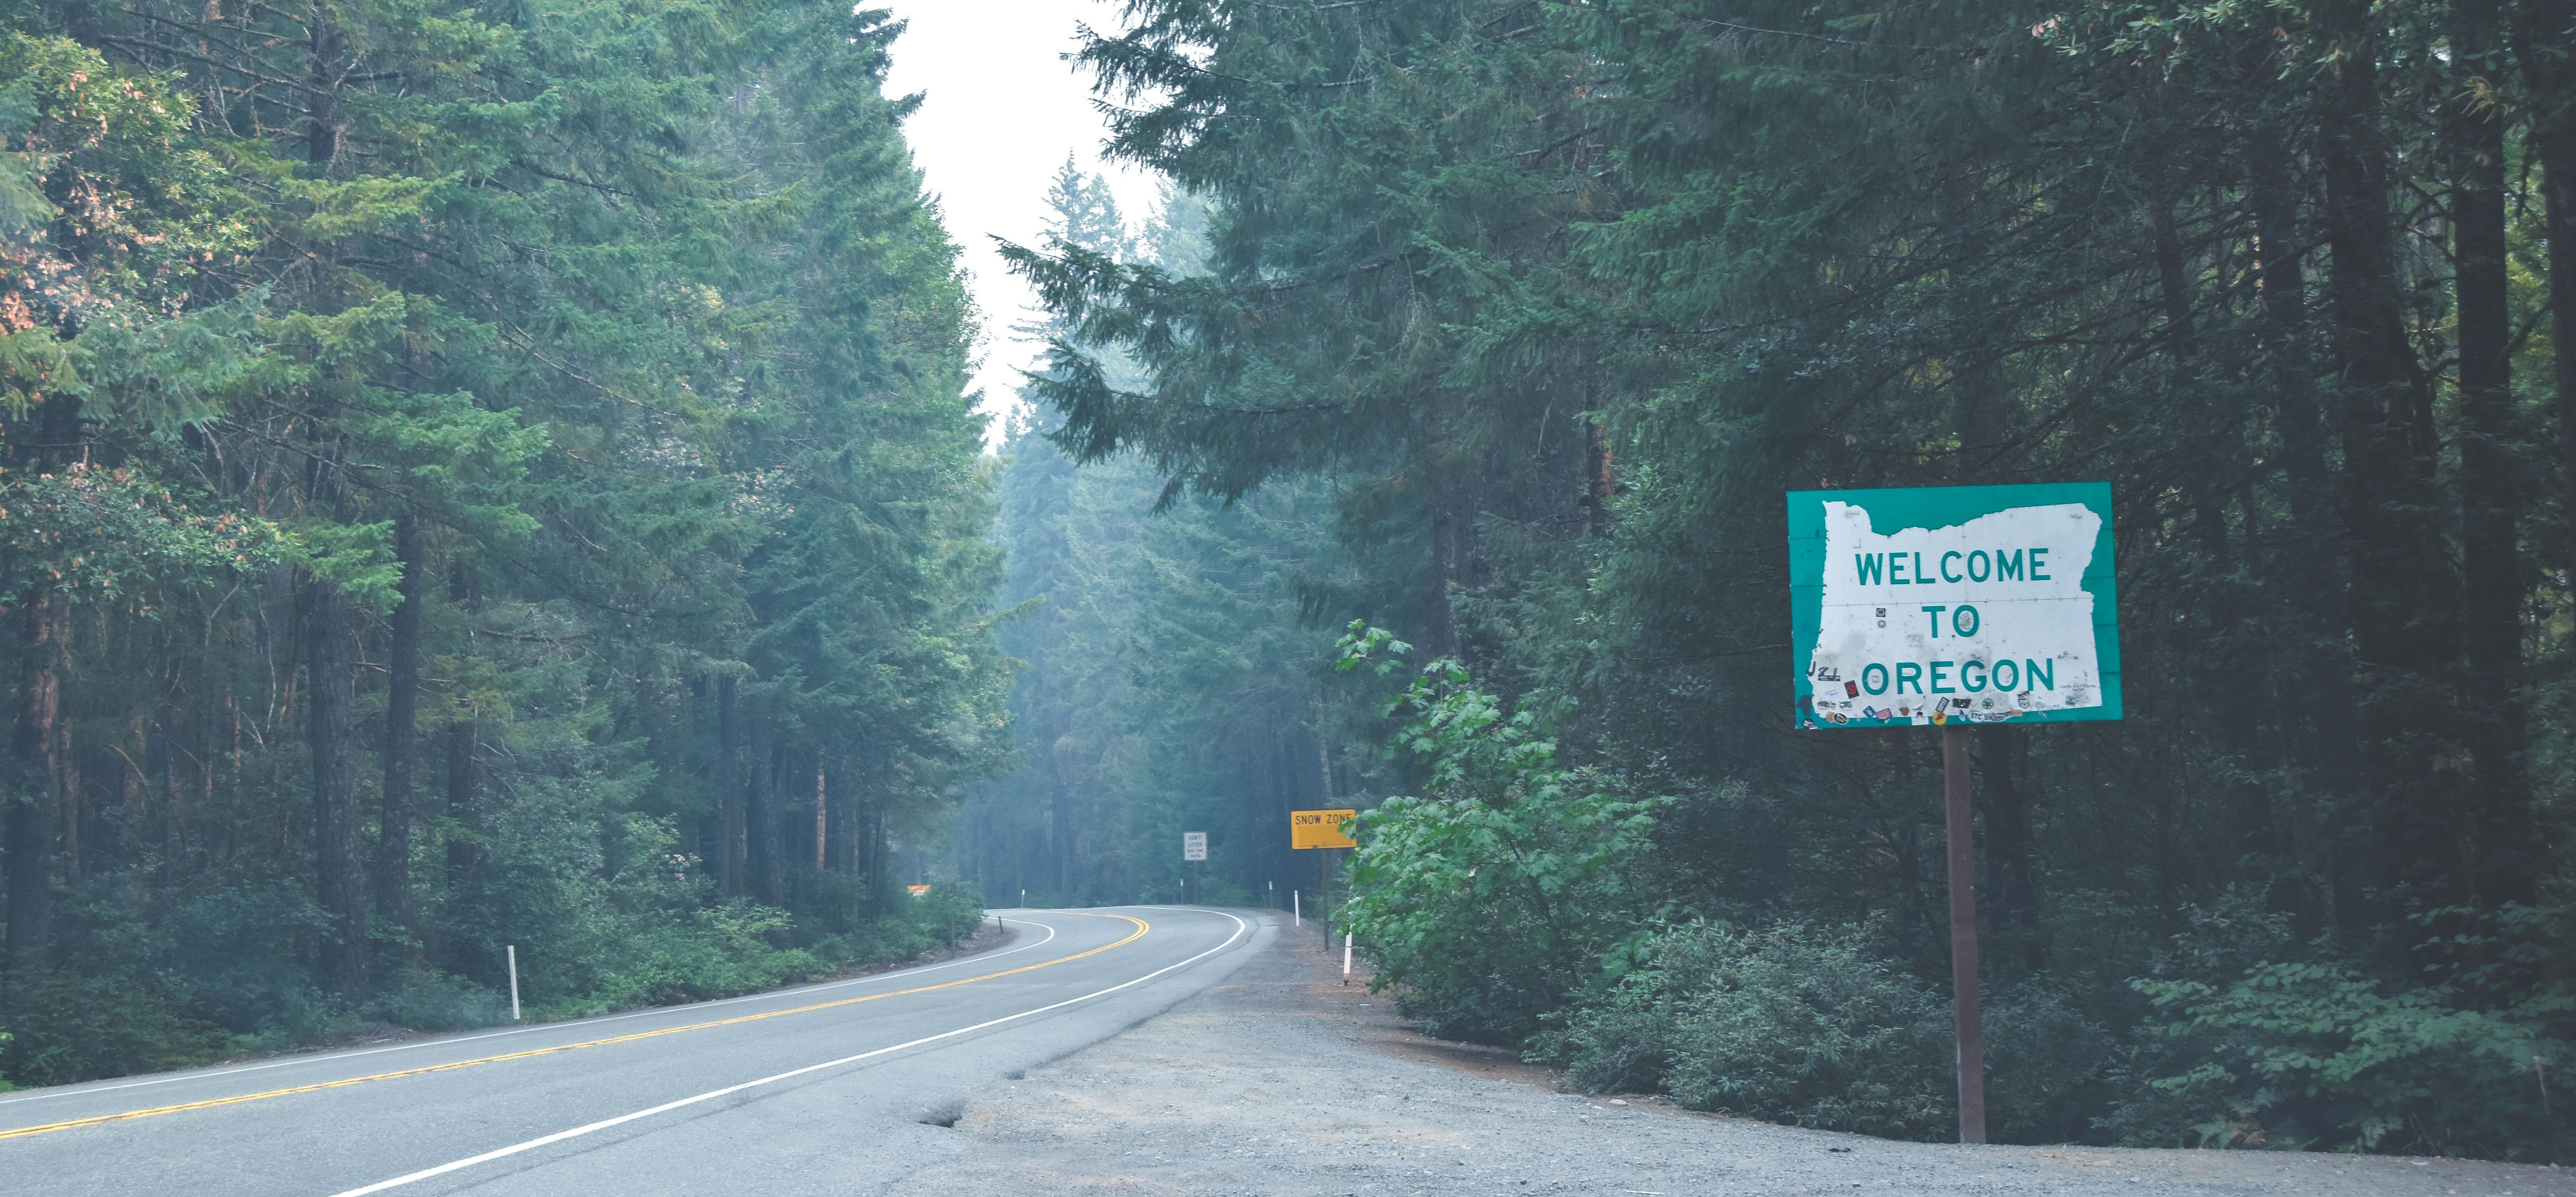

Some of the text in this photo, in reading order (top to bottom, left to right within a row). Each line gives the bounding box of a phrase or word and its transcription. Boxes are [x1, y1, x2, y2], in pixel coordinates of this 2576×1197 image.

[1855, 548, 2051, 586] WELCOME
[1922, 605, 1980, 638] TO
[1862, 658, 2054, 695] OREGON
[1295, 815, 1321, 824] SNOW
